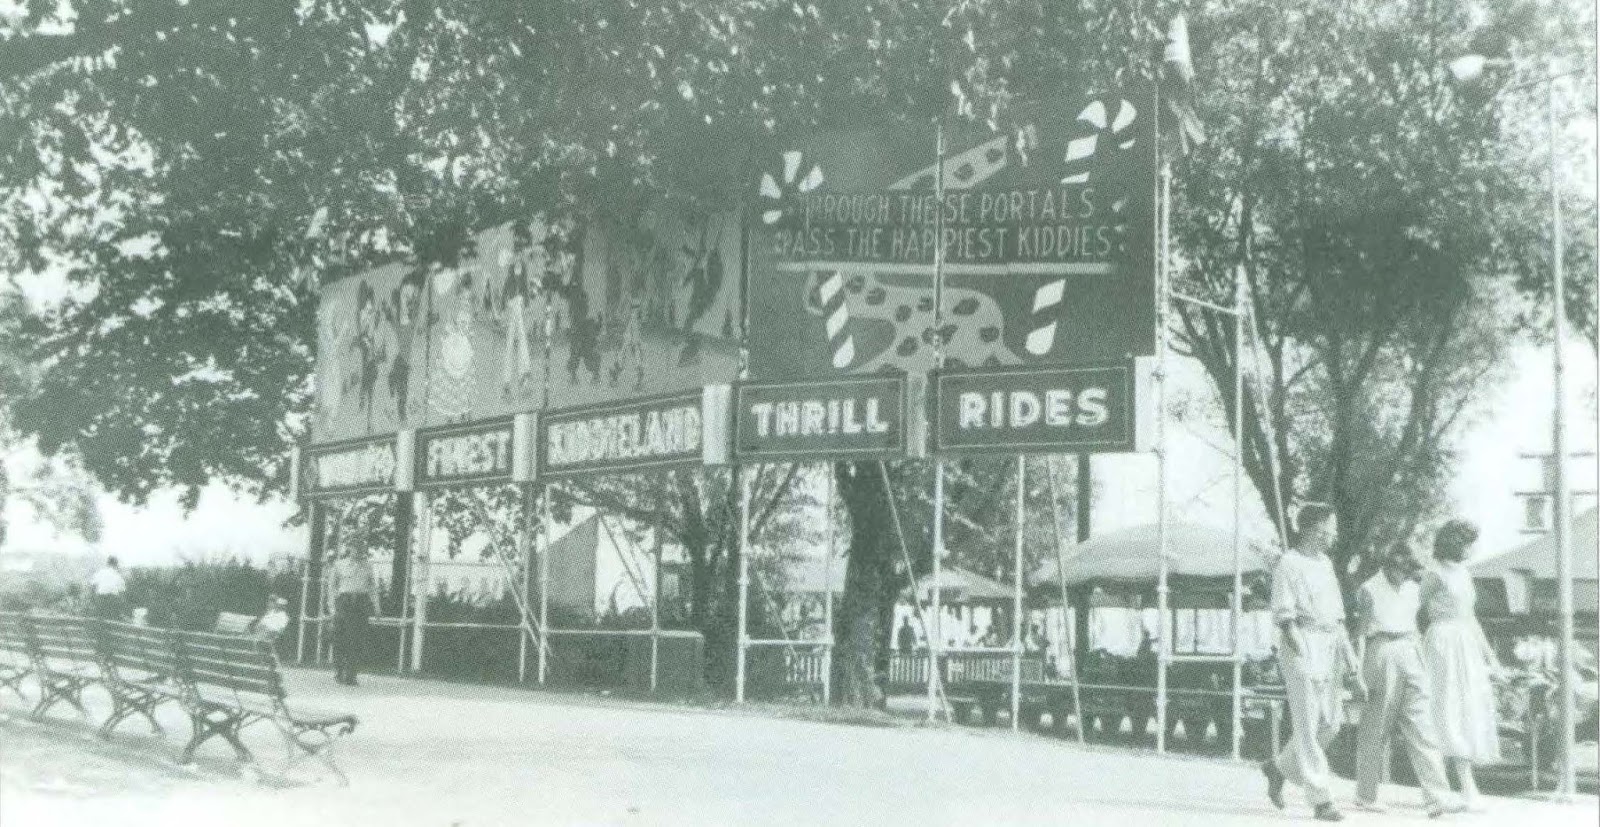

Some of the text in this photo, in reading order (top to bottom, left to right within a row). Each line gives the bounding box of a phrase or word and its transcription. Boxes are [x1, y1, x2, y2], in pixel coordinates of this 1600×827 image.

[900, 192, 970, 224] THESE
[981, 188, 1096, 222] PORTALS
[782, 226, 1112, 259] PASS THE HAPPIEST KIDDIES
[750, 398, 889, 437] THRILL
[959, 387, 1109, 429] RIDES
